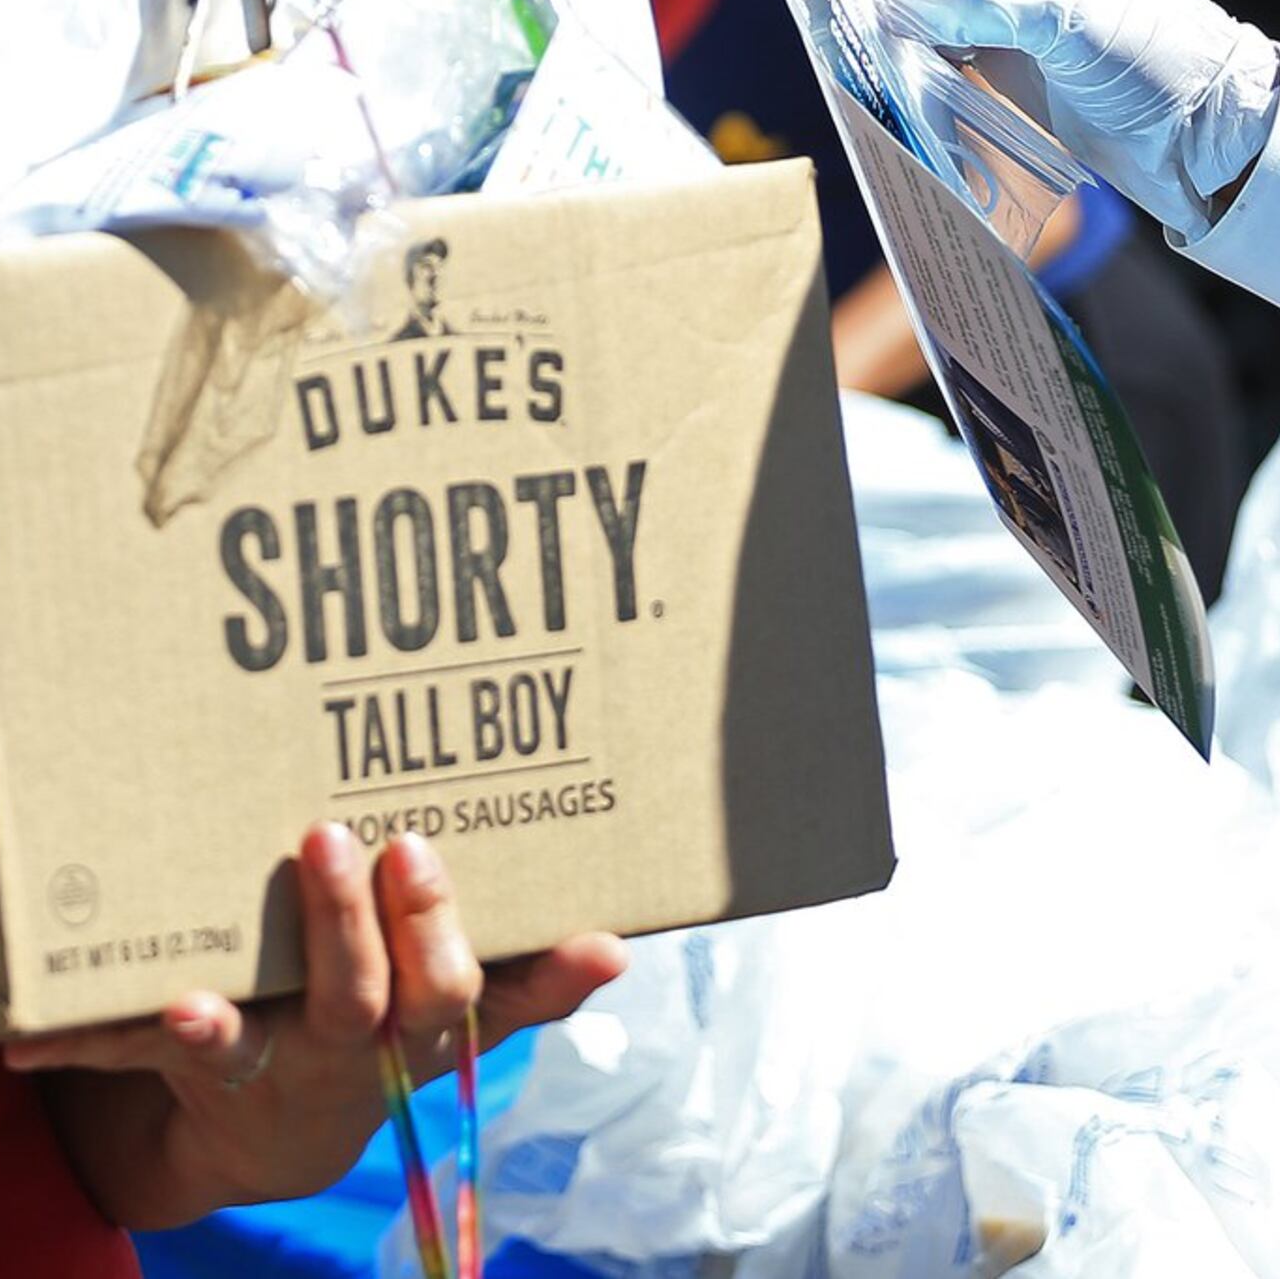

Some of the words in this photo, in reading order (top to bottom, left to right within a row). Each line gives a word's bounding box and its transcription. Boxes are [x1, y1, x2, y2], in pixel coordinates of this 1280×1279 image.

[325, 682, 459, 783] TALL
[473, 666, 575, 763] BOY
[334, 803, 445, 847] OKED
[453, 779, 617, 834] SAUSAGES
